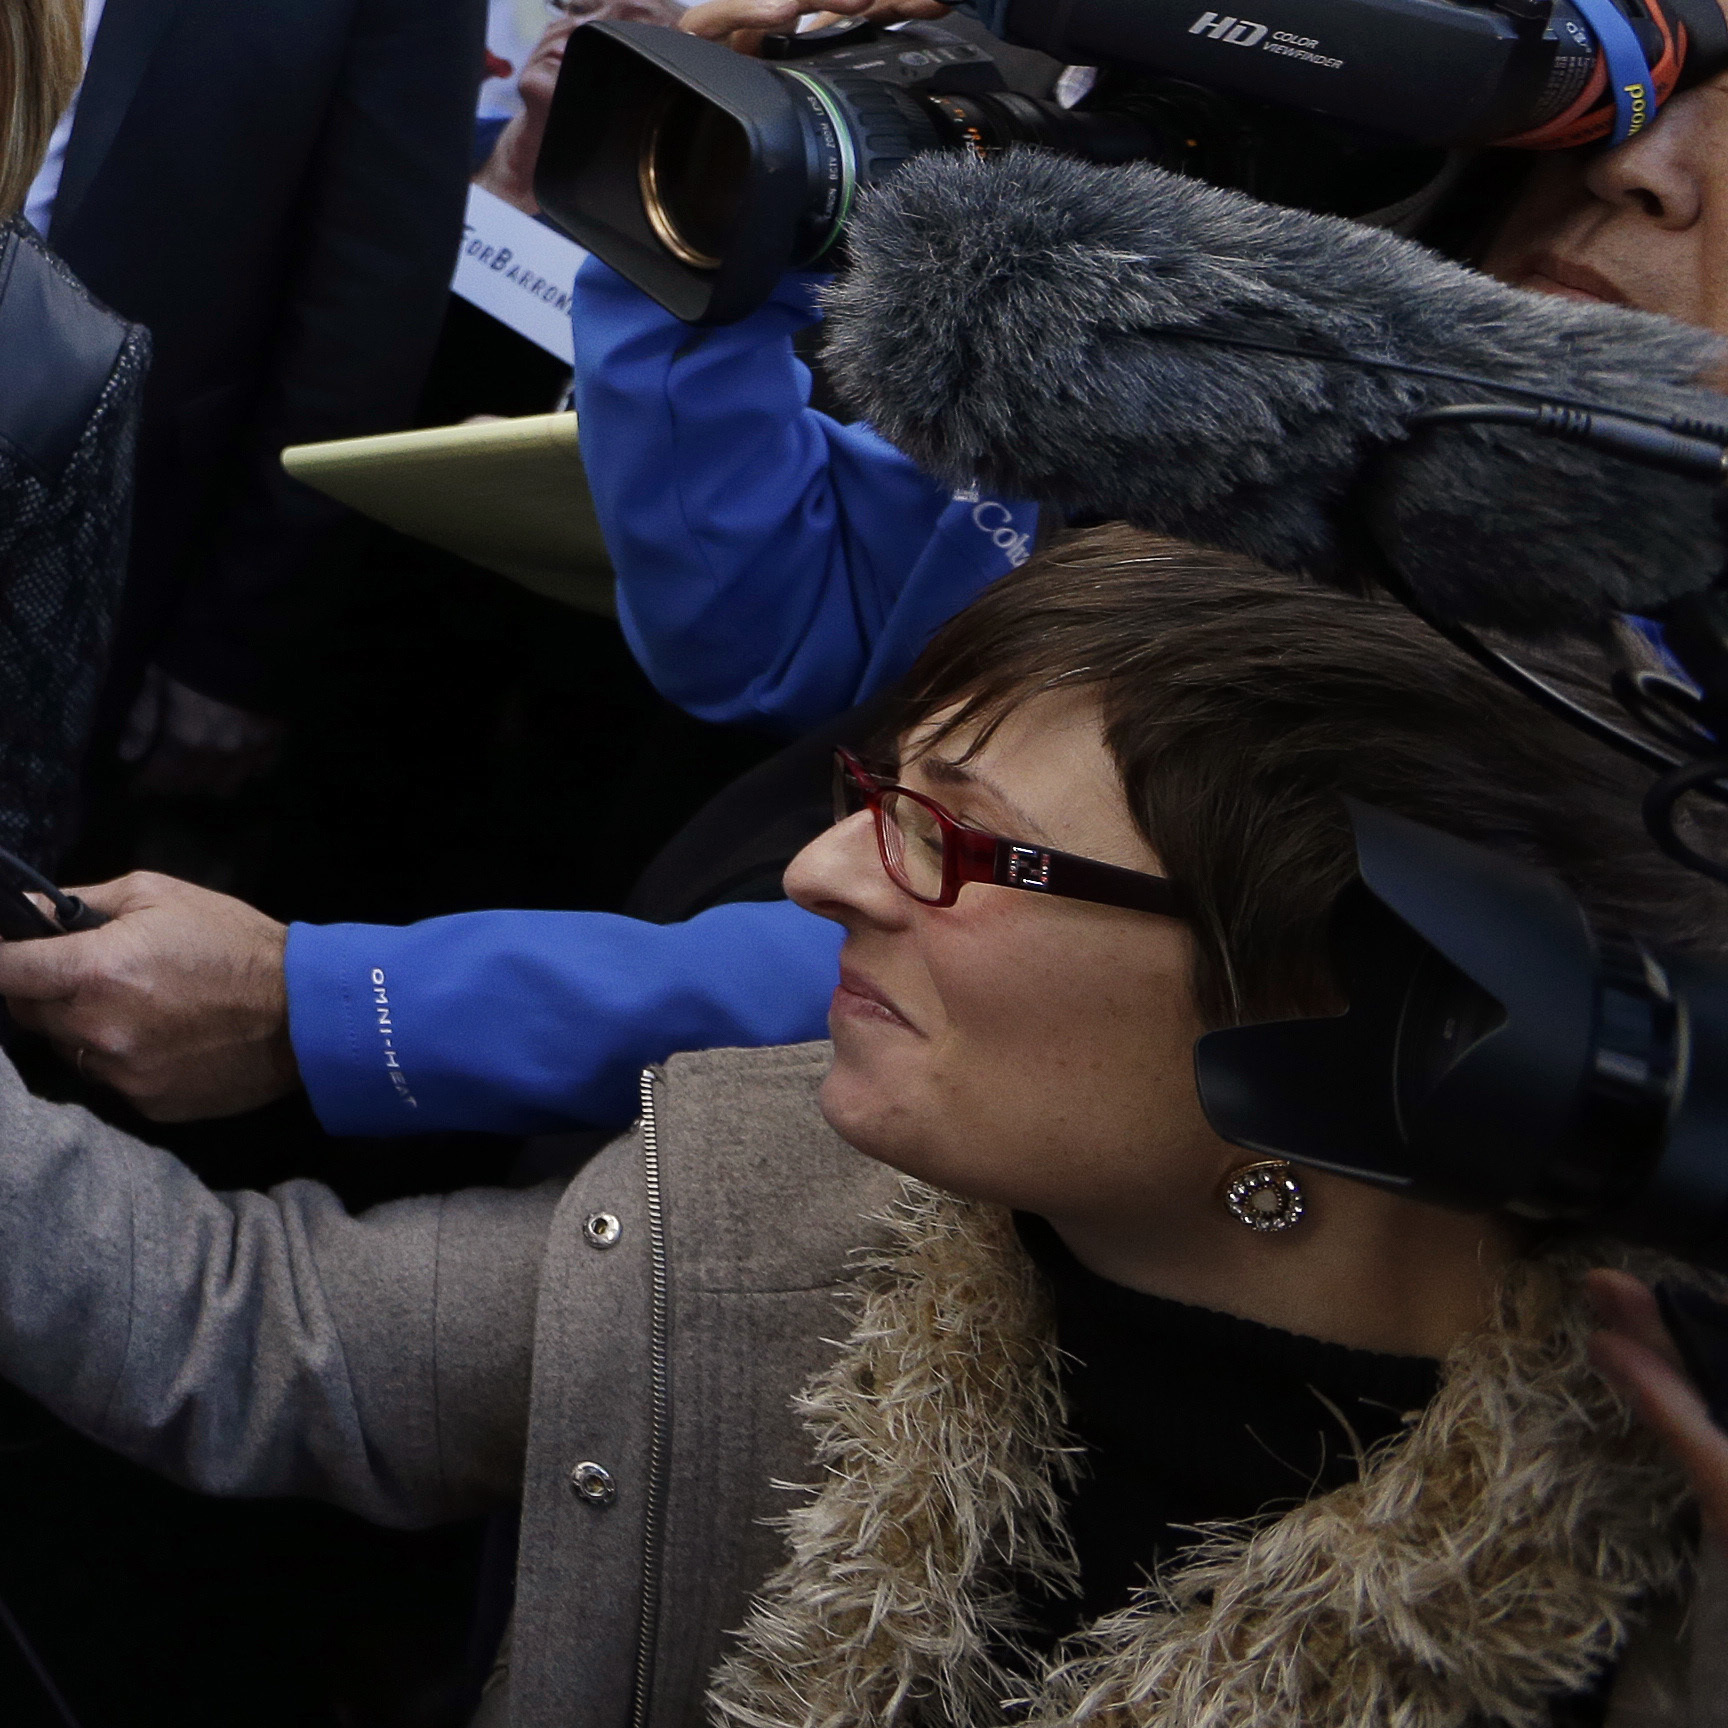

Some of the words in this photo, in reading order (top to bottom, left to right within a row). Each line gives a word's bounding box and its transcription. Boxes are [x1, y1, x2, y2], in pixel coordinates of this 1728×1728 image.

[1188, 10, 1269, 48] HD
[1272, 30, 1320, 50] COLOR
[1262, 40, 1345, 70] VIEWFINDER
[371, 967, 418, 1108] OMNI-HEAT
